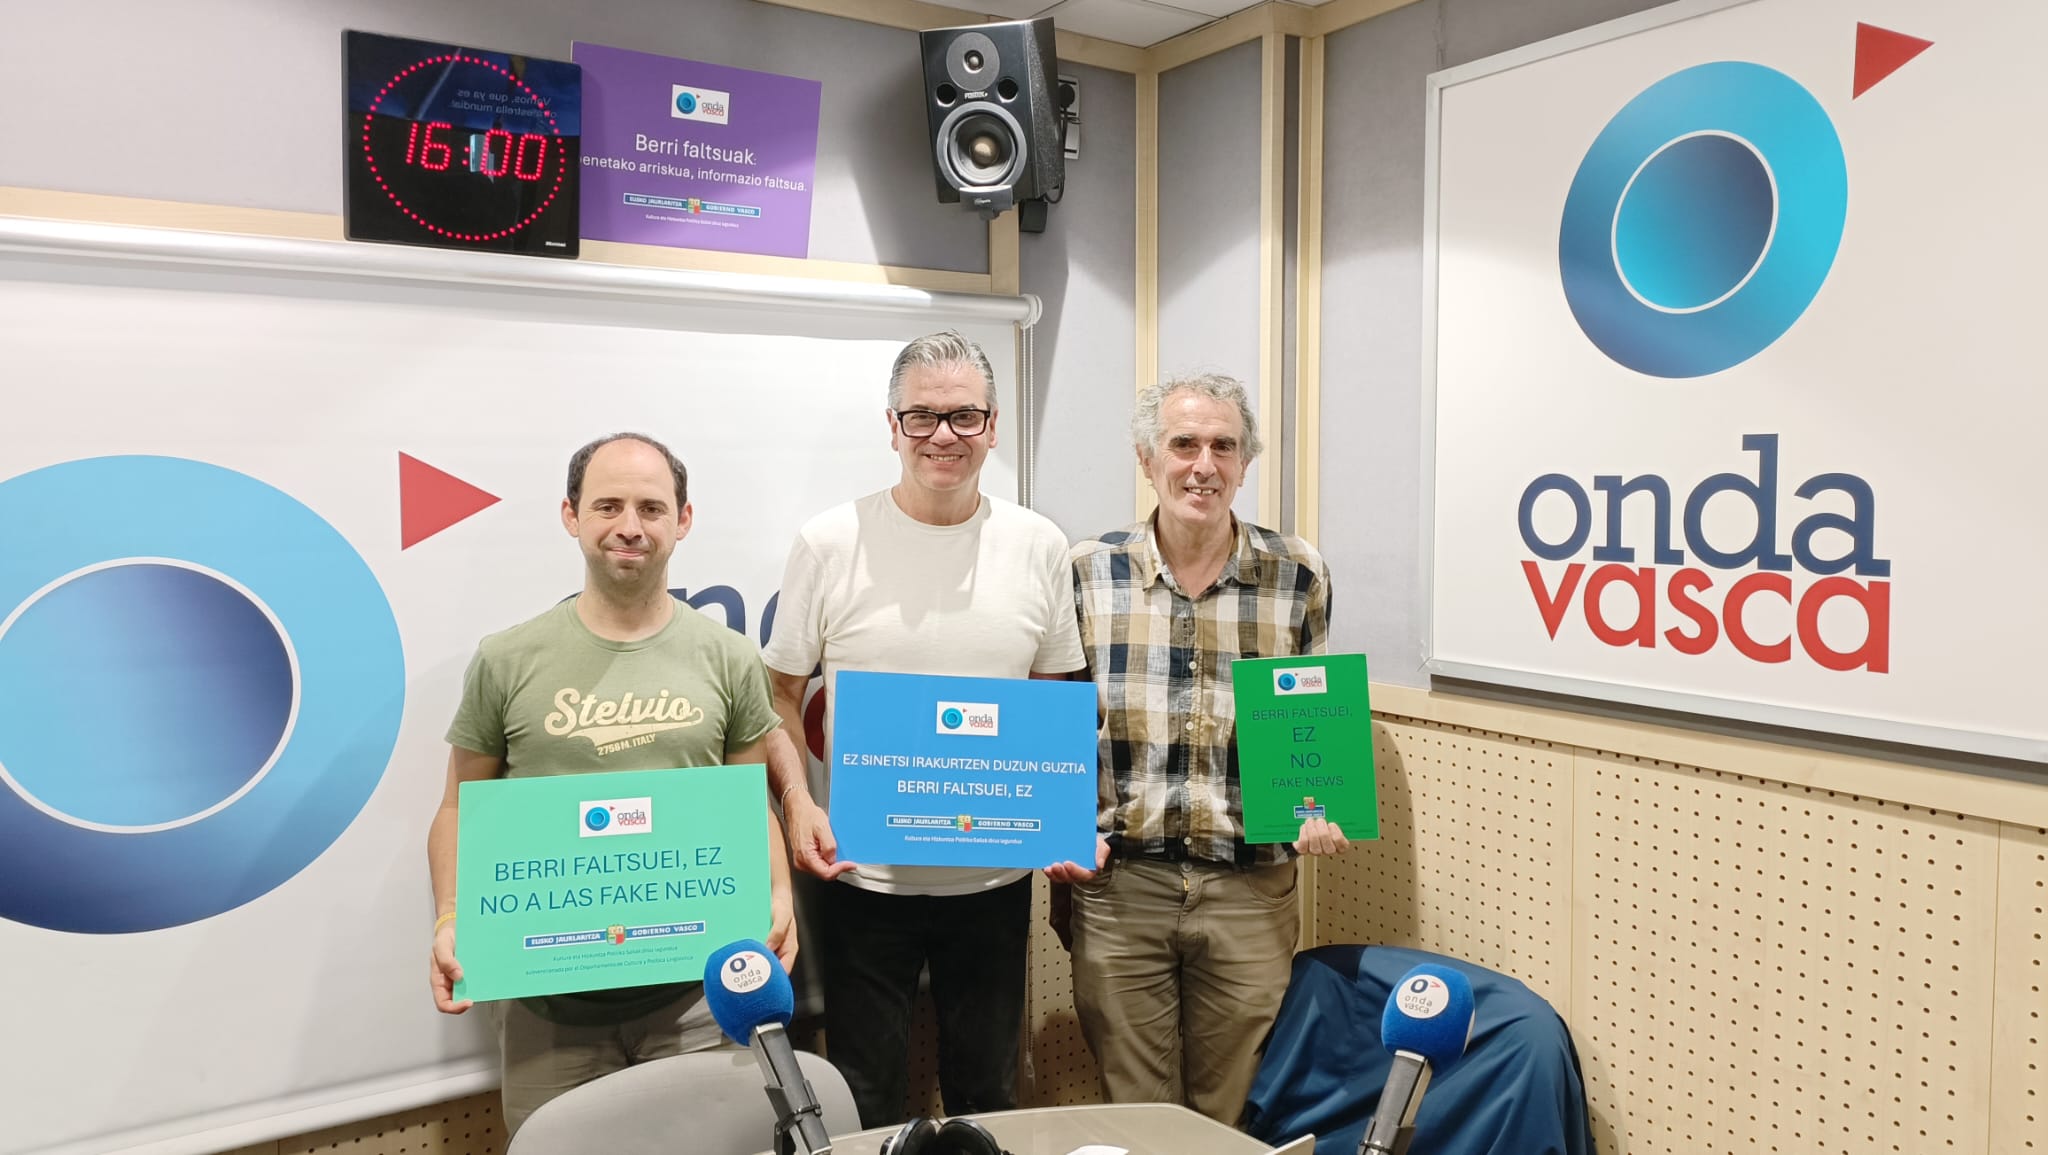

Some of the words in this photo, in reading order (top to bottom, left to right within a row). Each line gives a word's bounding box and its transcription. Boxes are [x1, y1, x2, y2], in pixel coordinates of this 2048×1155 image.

[702, 102, 724, 112] onda
[406, 122, 548, 180] 16:00
[636, 134, 678, 156] Berri
[580, 156, 636, 171] enetako
[639, 162, 694, 180] arriskua,
[698, 168, 761, 186] informazio
[764, 176, 806, 191] faltsua.
[1518, 433, 1890, 577] onda
[1520, 560, 1890, 674] vasca
[544, 688, 703, 736] Stelvio
[969, 714, 992, 722] onda
[1252, 709, 1288, 720] BERRI
[633, 733, 656, 747] ITALY
[1293, 726, 1316, 742] EZ
[843, 754, 858, 765] EZ
[861, 754, 909, 767] SINETSI
[912, 757, 990, 770] IRAKURTZEN
[993, 760, 1038, 772] DUZUN
[1041, 762, 1086, 774] GUZTIA
[1291, 752, 1321, 768] NO
[898, 780, 939, 794] BERRI
[944, 782, 1011, 798] FALTSUEI,
[1016, 785, 1032, 797] EZ
[1272, 777, 1302, 788] FAKE
[1306, 776, 1344, 786] NEWS
[617, 809, 645, 820] onda
[618, 816, 646, 826] vasca
[495, 858, 565, 882] BERRI
[574, 850, 687, 875] FALTSUEI,
[696, 847, 722, 866] EZ
[480, 894, 518, 915] NO
[525, 892, 541, 911] A
[549, 888, 593, 910] LAS
[600, 883, 658, 905] FAKE
[666, 876, 736, 900] NEWS
[632, 927, 671, 936] GOBIERNO
[673, 924, 698, 932] VASCO
[734, 969, 761, 983] onda
[737, 975, 763, 988] vasca
[1404, 995, 1432, 1007] onda
[1404, 1002, 1429, 1014] vasca
